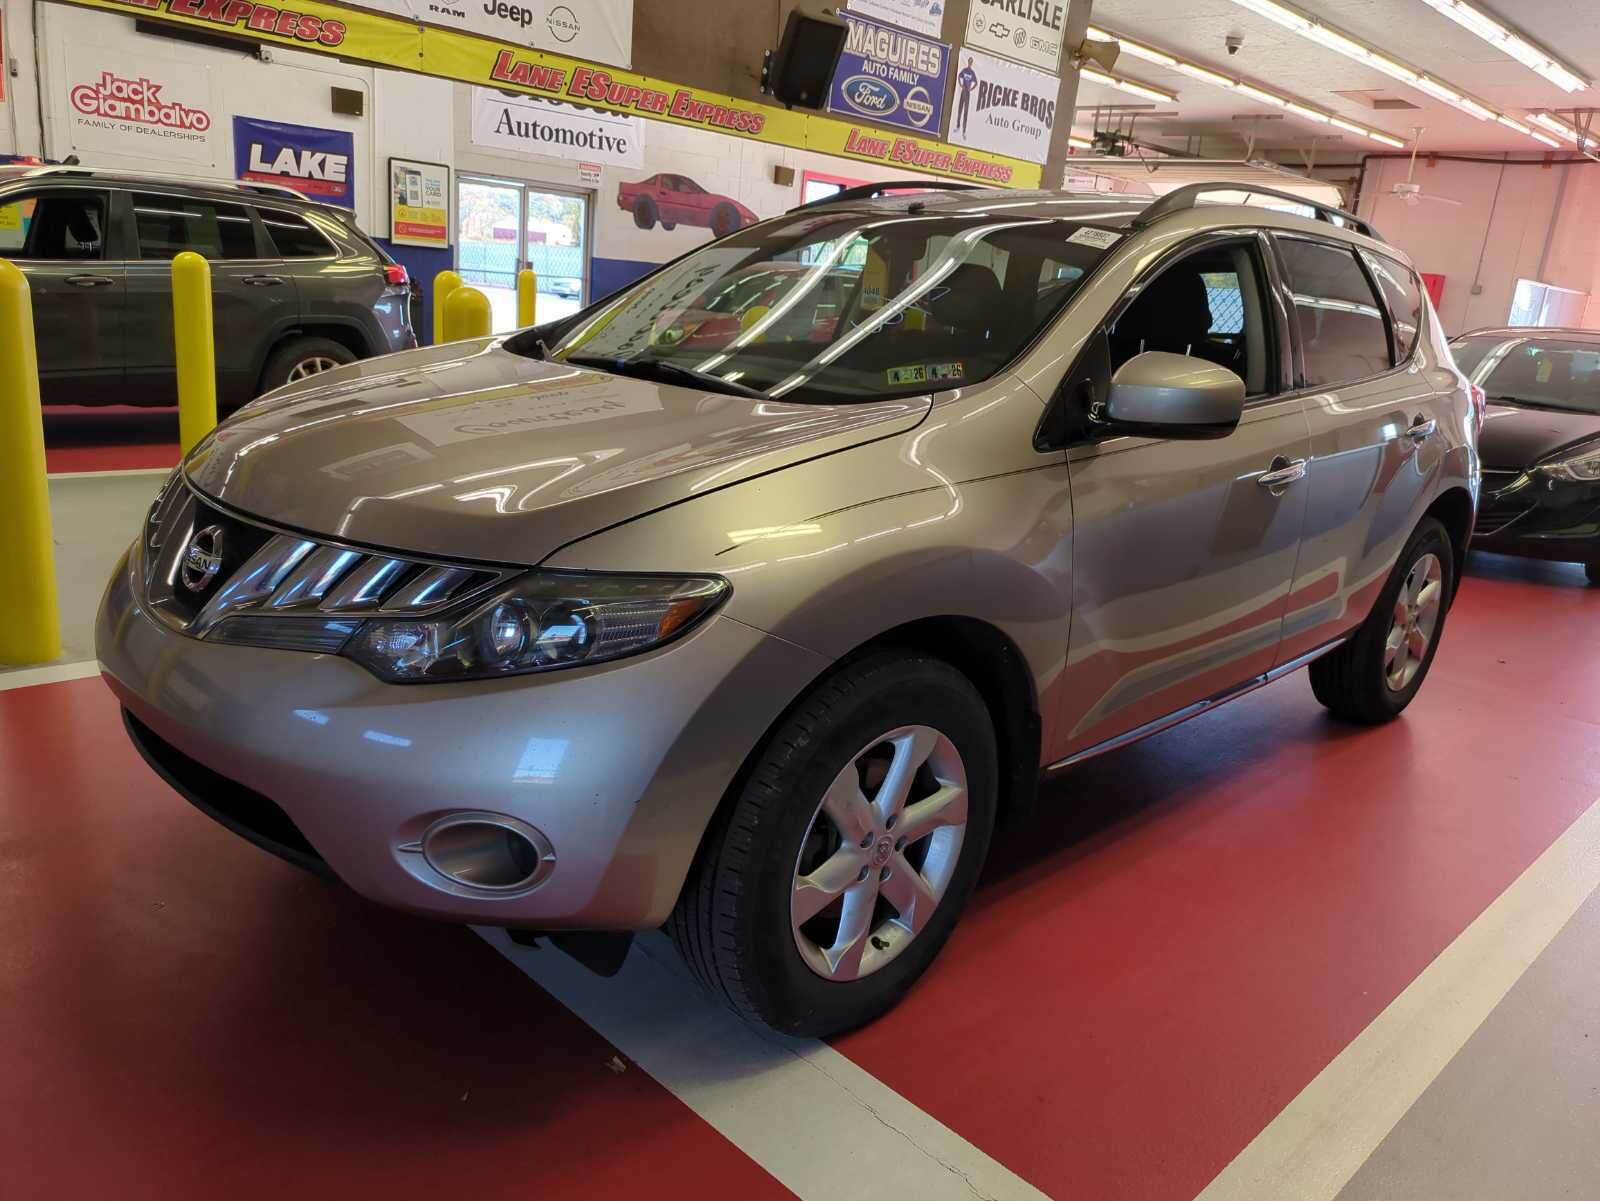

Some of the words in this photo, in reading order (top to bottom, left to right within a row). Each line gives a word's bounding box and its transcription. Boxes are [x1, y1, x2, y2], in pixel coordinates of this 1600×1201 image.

[429, 4, 466, 18] RAM
[483, 0, 533, 28] Jeep
[545, 17, 581, 32] NISSAN
[980, 0, 1063, 31] RLISLE
[845, 19, 941, 76] MAGUIRES
[1029, 36, 1058, 56] GMC
[96, 71, 162, 103] Jack
[862, 60, 887, 77] AUTO
[888, 67, 920, 85] FAMILY
[491, 50, 567, 92] LANE
[669, 89, 766, 134] EXPRESS
[854, 82, 887, 110] Ford
[975, 80, 1019, 112] RICKE
[1020, 92, 1055, 130] BROS
[70, 84, 211, 132] Giambalvo
[905, 101, 932, 114] NISSAN
[78, 118, 116, 130] FAMILY
[120, 124, 133, 133] OF
[135, 126, 206, 143] DEALERSHIPS
[494, 108, 627, 154] Automotive
[985, 112, 1009, 129] Auto
[1011, 121, 1042, 140] Group
[248, 143, 348, 183] LAKE
[844, 127, 890, 158] LANE
[951, 151, 1013, 183] EXPRESS
